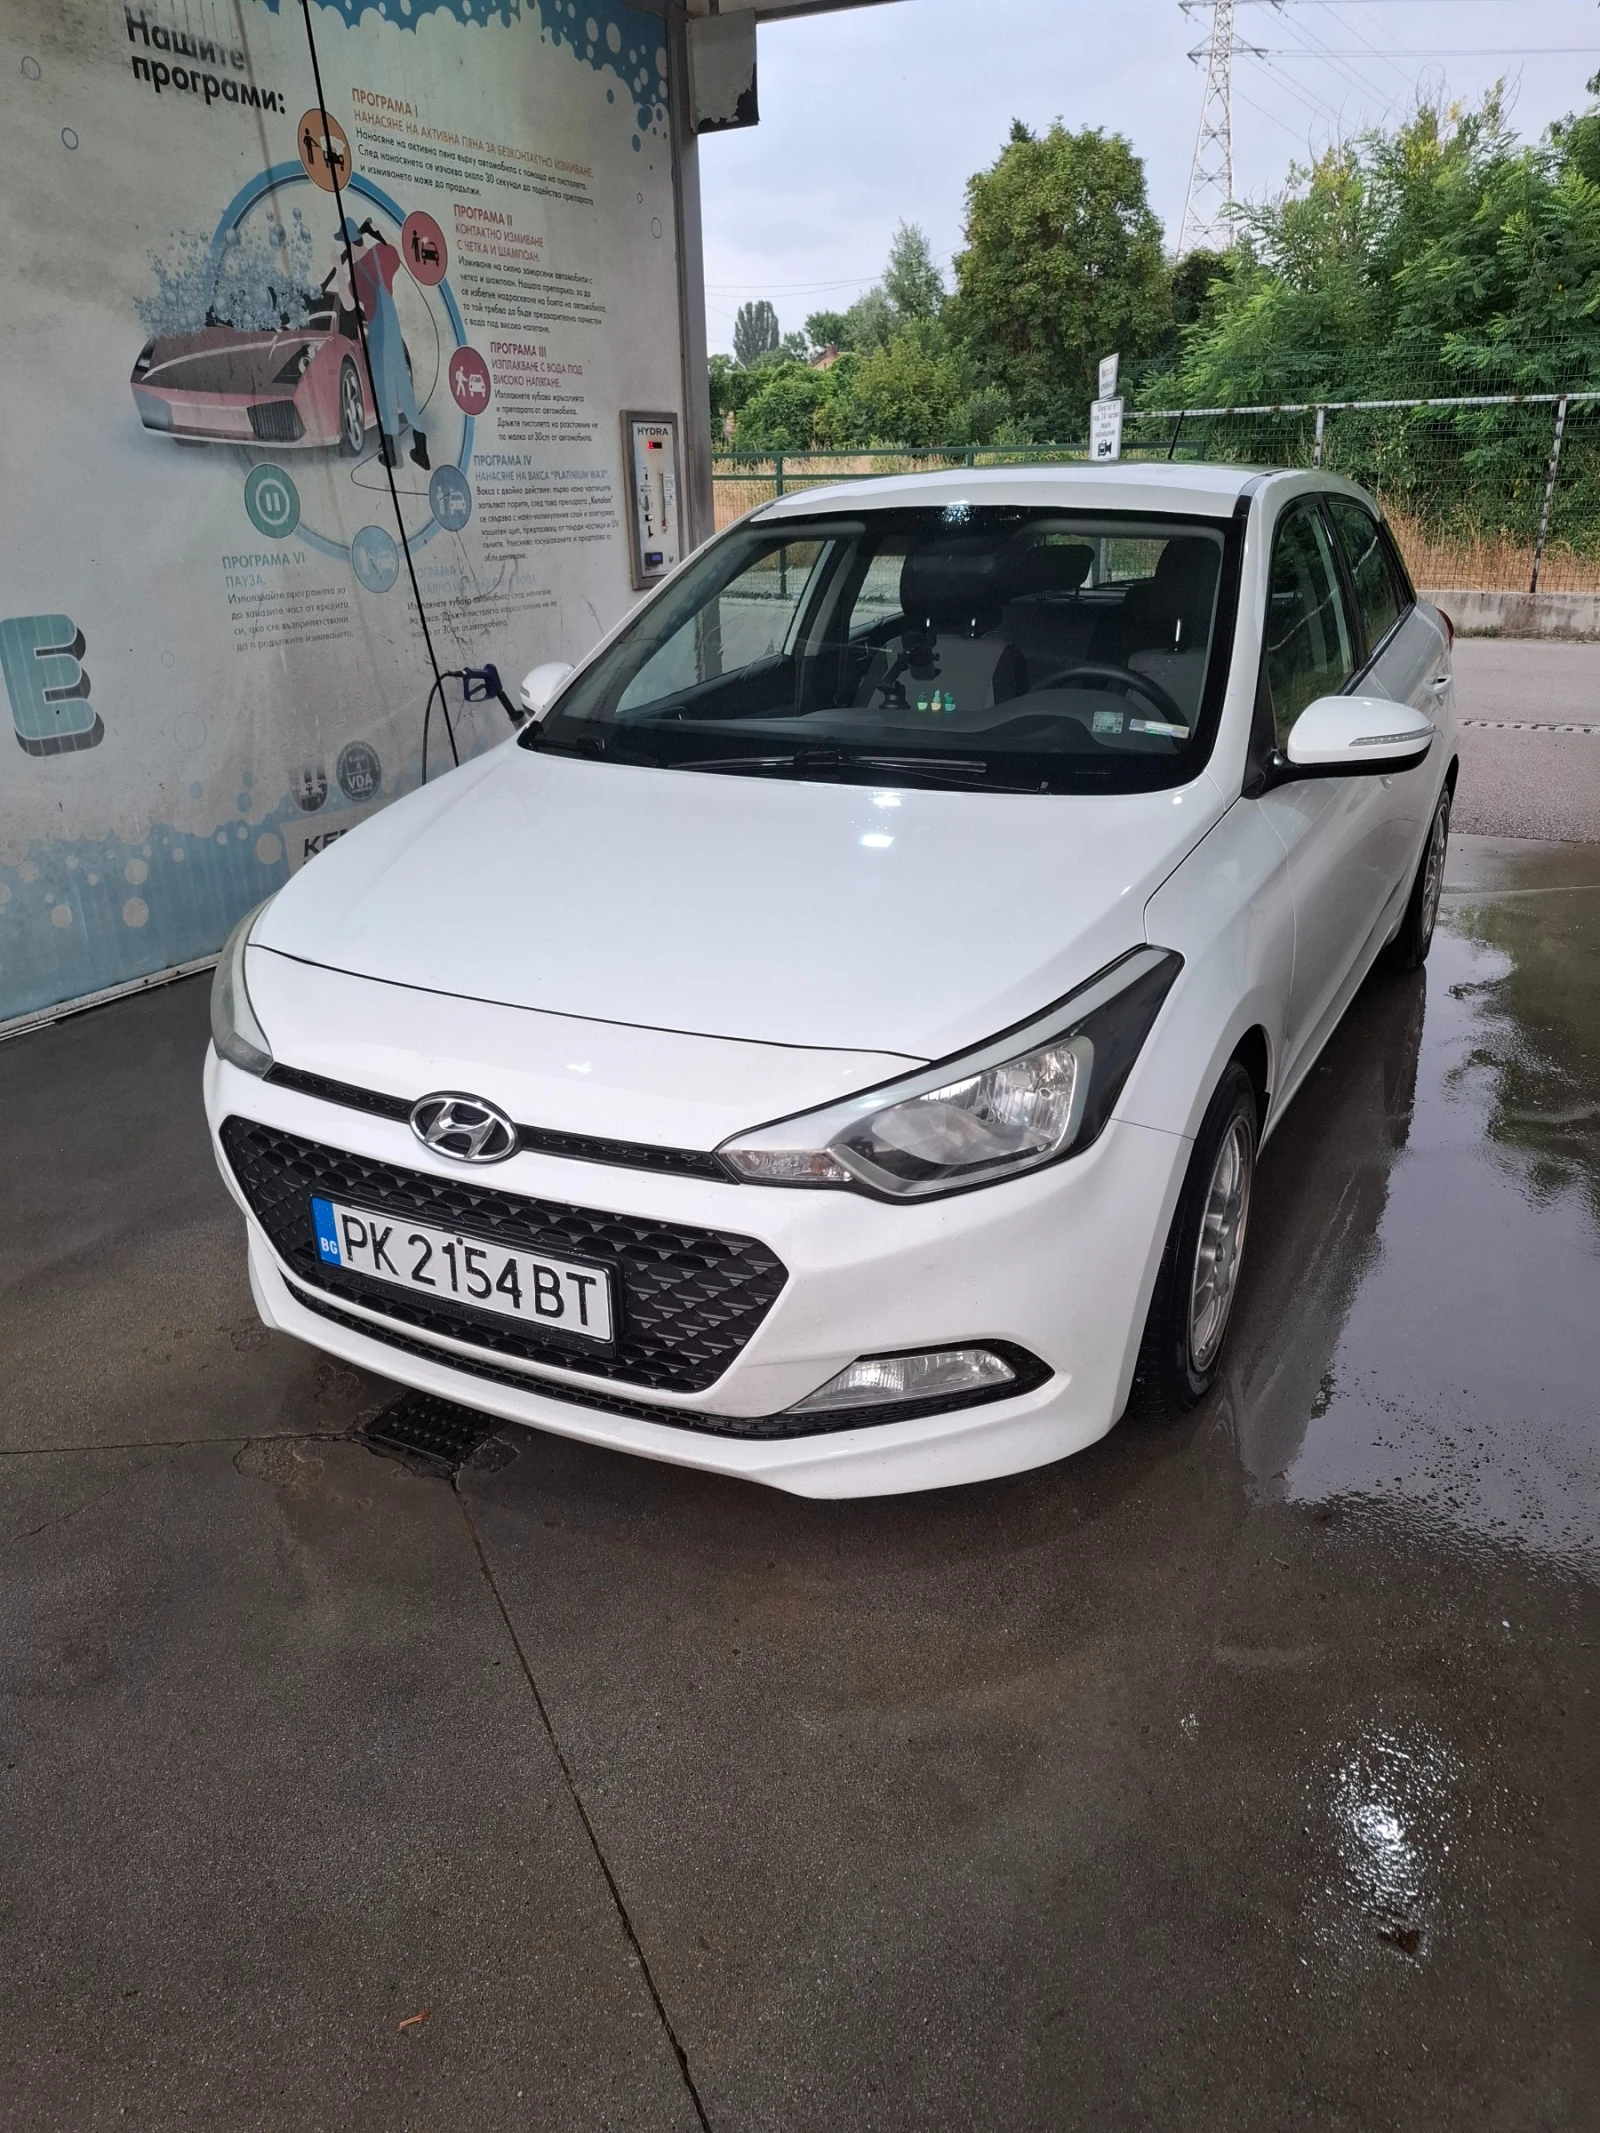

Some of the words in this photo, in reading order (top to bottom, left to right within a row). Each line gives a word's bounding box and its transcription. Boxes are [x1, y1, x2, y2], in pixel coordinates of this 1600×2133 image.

[124, 5, 245, 71] Нашите
[131, 55, 285, 115] програми:
[352, 88, 412, 116] ПРОГРАМА
[354, 109, 403, 132] НАНАСЯНЕ
[406, 122, 419, 136] НА
[421, 126, 460, 146] АКТИВНА
[461, 136, 484, 151] ПЯНА
[486, 142, 496, 154] ЗА
[498, 145, 553, 168] БЕЗКОНТАКТНО
[355, 127, 395, 146] Нанасяне
[396, 141, 406, 149] на
[408, 143, 437, 156] активна
[438, 150, 456, 160] пяна
[457, 154, 476, 167] върху
[478, 161, 517, 174] автомобила
[357, 144, 379, 160] След
[380, 152, 423, 169] нанасянето
[425, 162, 433, 171] се
[434, 163, 463, 177] изчаква
[464, 171, 484, 182] около
[485, 172, 495, 184] 30
[496, 177, 521, 189] секунди
[523, 184, 531, 192] да
[367, 166, 412, 182] измиването
[414, 176, 433, 186] може
[435, 180, 444, 189] да
[453, 204, 505, 225] ПРОГРАМА
[507, 215, 513, 227] II
[455, 223, 502, 241] КОНТАКТНО
[503, 231, 544, 248] ИЗМИВАНЕ
[464, 241, 489, 255] ЧЕТКА
[490, 244, 497, 254] И
[457, 255, 492, 270] Измиване
[493, 263, 502, 271] на
[503, 264, 522, 274] силно
[460, 273, 478, 282] четка
[518, 279, 541, 291] Нашата
[584, 290, 591, 298] да
[461, 288, 469, 296] се
[470, 287, 496, 300] избегне
[497, 291, 537, 304] надраскване
[538, 297, 545, 305] на
[546, 296, 563, 308] боята
[564, 301, 572, 309] на
[463, 302, 471, 310] то
[472, 302, 483, 311] той
[484, 303, 507, 316] трябва
[508, 307, 516, 316] да
[517, 306, 532, 318] бъде
[533, 309, 577, 323] предварително
[470, 318, 486, 328] вода
[486, 320, 499, 329] под
[500, 321, 522, 331] високо
[490, 341, 537, 357] ПРОГРАМА
[538, 346, 547, 358] III
[491, 358, 539, 373] ИЗПЛАКВАНЕ
[547, 362, 567, 375] ВОДА
[567, 364, 583, 376] ПОД
[493, 374, 525, 387] ВИСОКО
[494, 389, 531, 401] Изплакнете
[531, 391, 552, 403] хубаво
[501, 405, 535, 415] препарата
[497, 417, 521, 429] Дръжте
[637, 427, 669, 436] HYDRA
[473, 455, 521, 467] ПРОГРАМА
[523, 455, 532, 466] IV
[475, 470, 514, 482] НАНАСЯНЕ
[516, 470, 526, 481] НА
[528, 470, 549, 481] ВАКСА
[476, 486, 495, 496] Вакса
[501, 486, 523, 496] двойно
[222, 553, 290, 570] ПРОГРАМА
[293, 551, 305, 565] VI
[225, 573, 267, 589] ПАУЗА.
[227, 590, 285, 604] Използвайте
[286, 587, 335, 601] програмата
[337, 587, 346, 595] за
[231, 612, 243, 621] да
[285, 606, 304, 615] част
[305, 604, 315, 612] от
[316, 600, 349, 613] кредита
[266, 623, 280, 632] сте
[236, 642, 248, 652] да
[347, 773, 374, 789] VDA
[320, 1237, 338, 1255] BG
[341, 1213, 400, 1276] PK
[407, 1234, 523, 1310] 2154
[533, 1263, 597, 1327] BT
